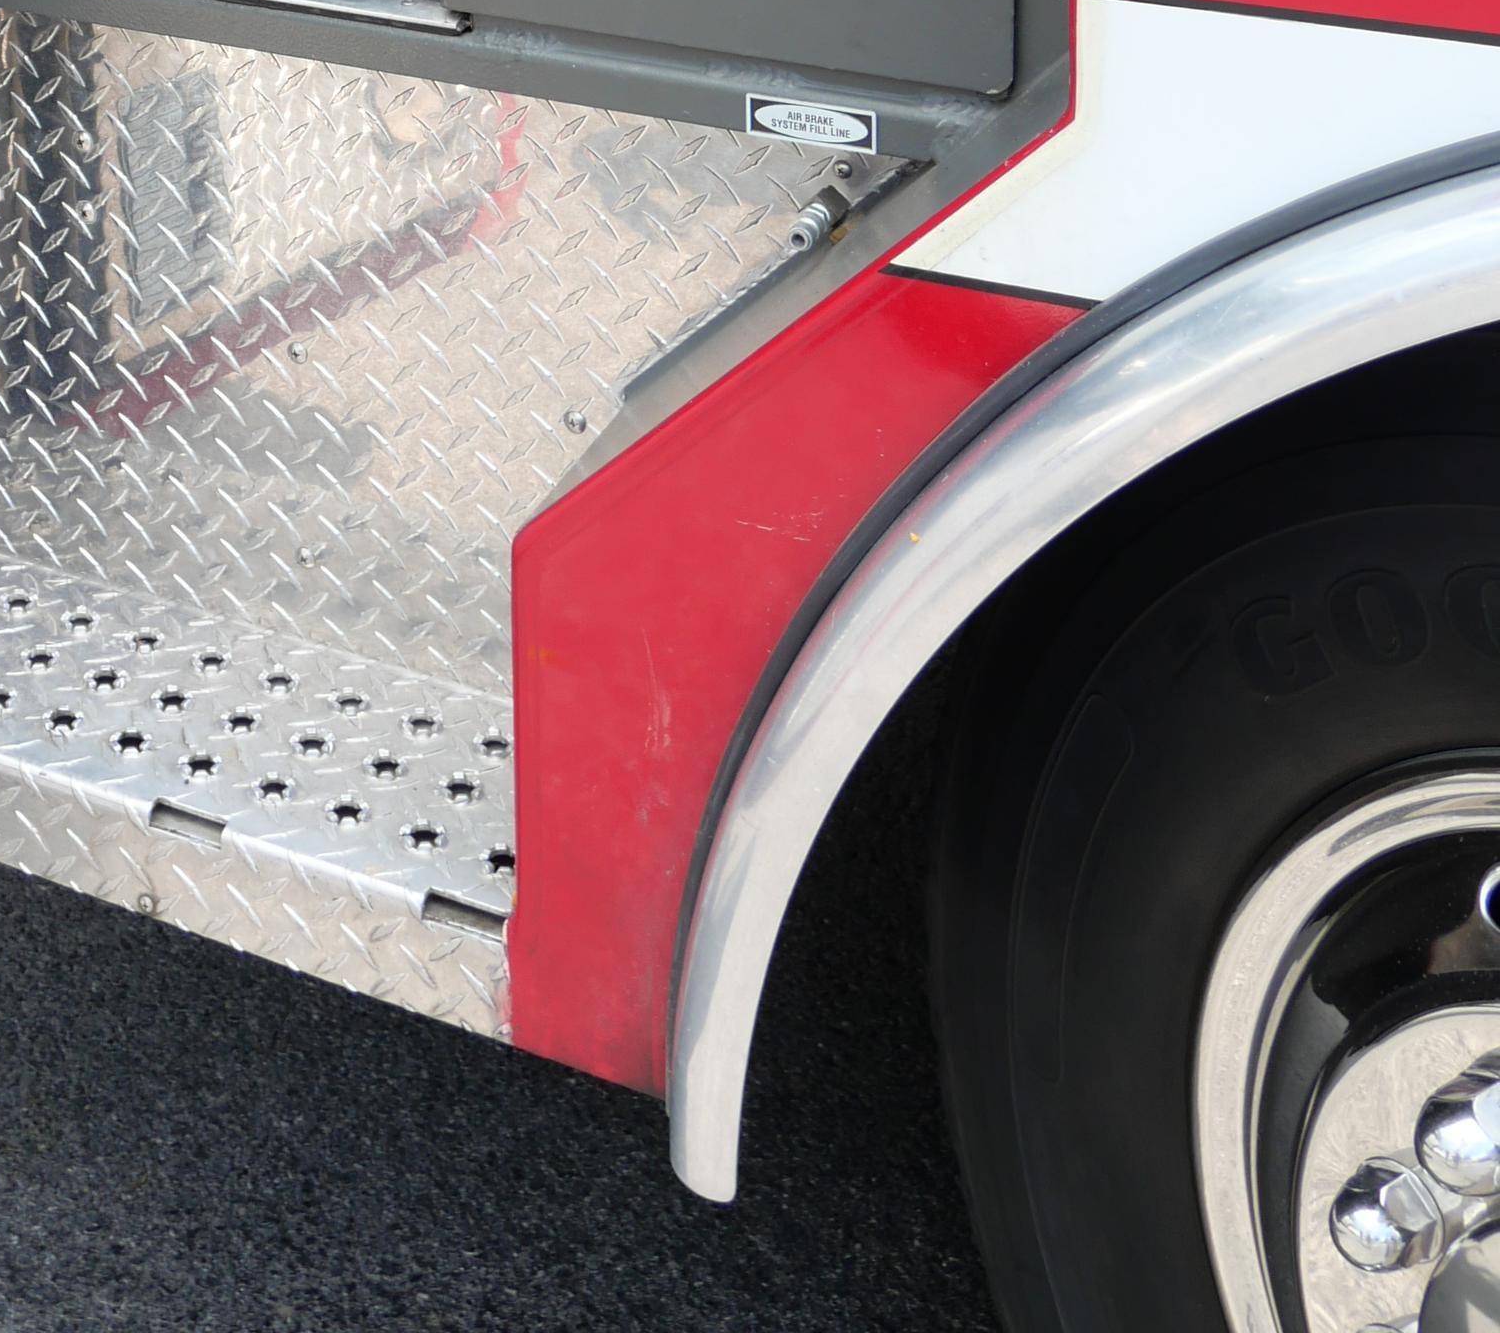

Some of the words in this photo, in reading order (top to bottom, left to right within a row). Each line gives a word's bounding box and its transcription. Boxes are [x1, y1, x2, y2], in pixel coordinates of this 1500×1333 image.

[787, 111, 802, 121] AIR
[805, 114, 834, 126] BRAKE
[771, 118, 807, 132] SYSTEM
[809, 124, 828, 136] FILL
[831, 127, 851, 139] LINE
